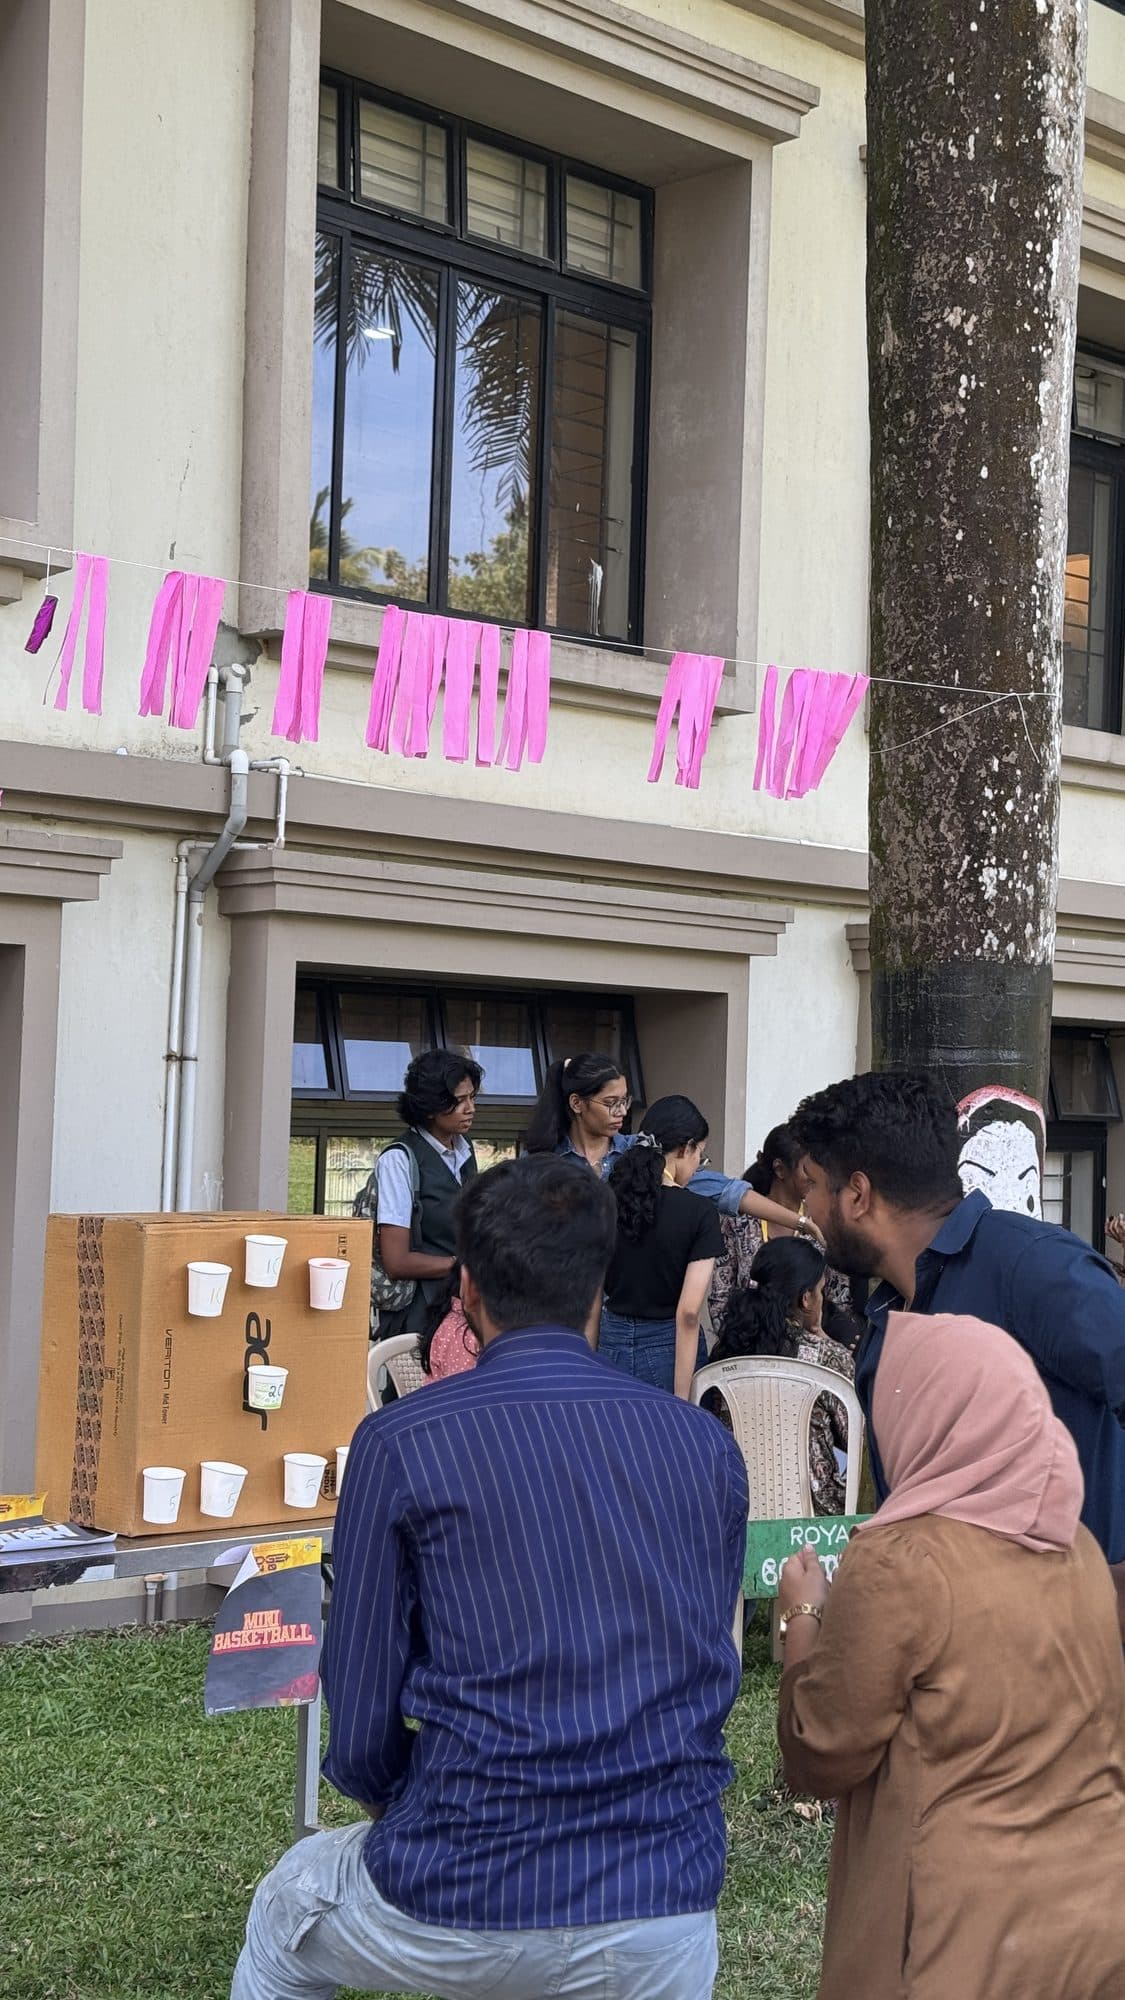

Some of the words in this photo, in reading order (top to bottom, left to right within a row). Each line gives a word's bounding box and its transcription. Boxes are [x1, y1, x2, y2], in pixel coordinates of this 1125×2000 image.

[328, 1279, 345, 1303] 10
[242, 1311, 272, 1431] acr
[790, 1523, 850, 1546] ROYA
[243, 1609, 281, 1632] MINI
[213, 1623, 314, 1653] BASKETBALL
